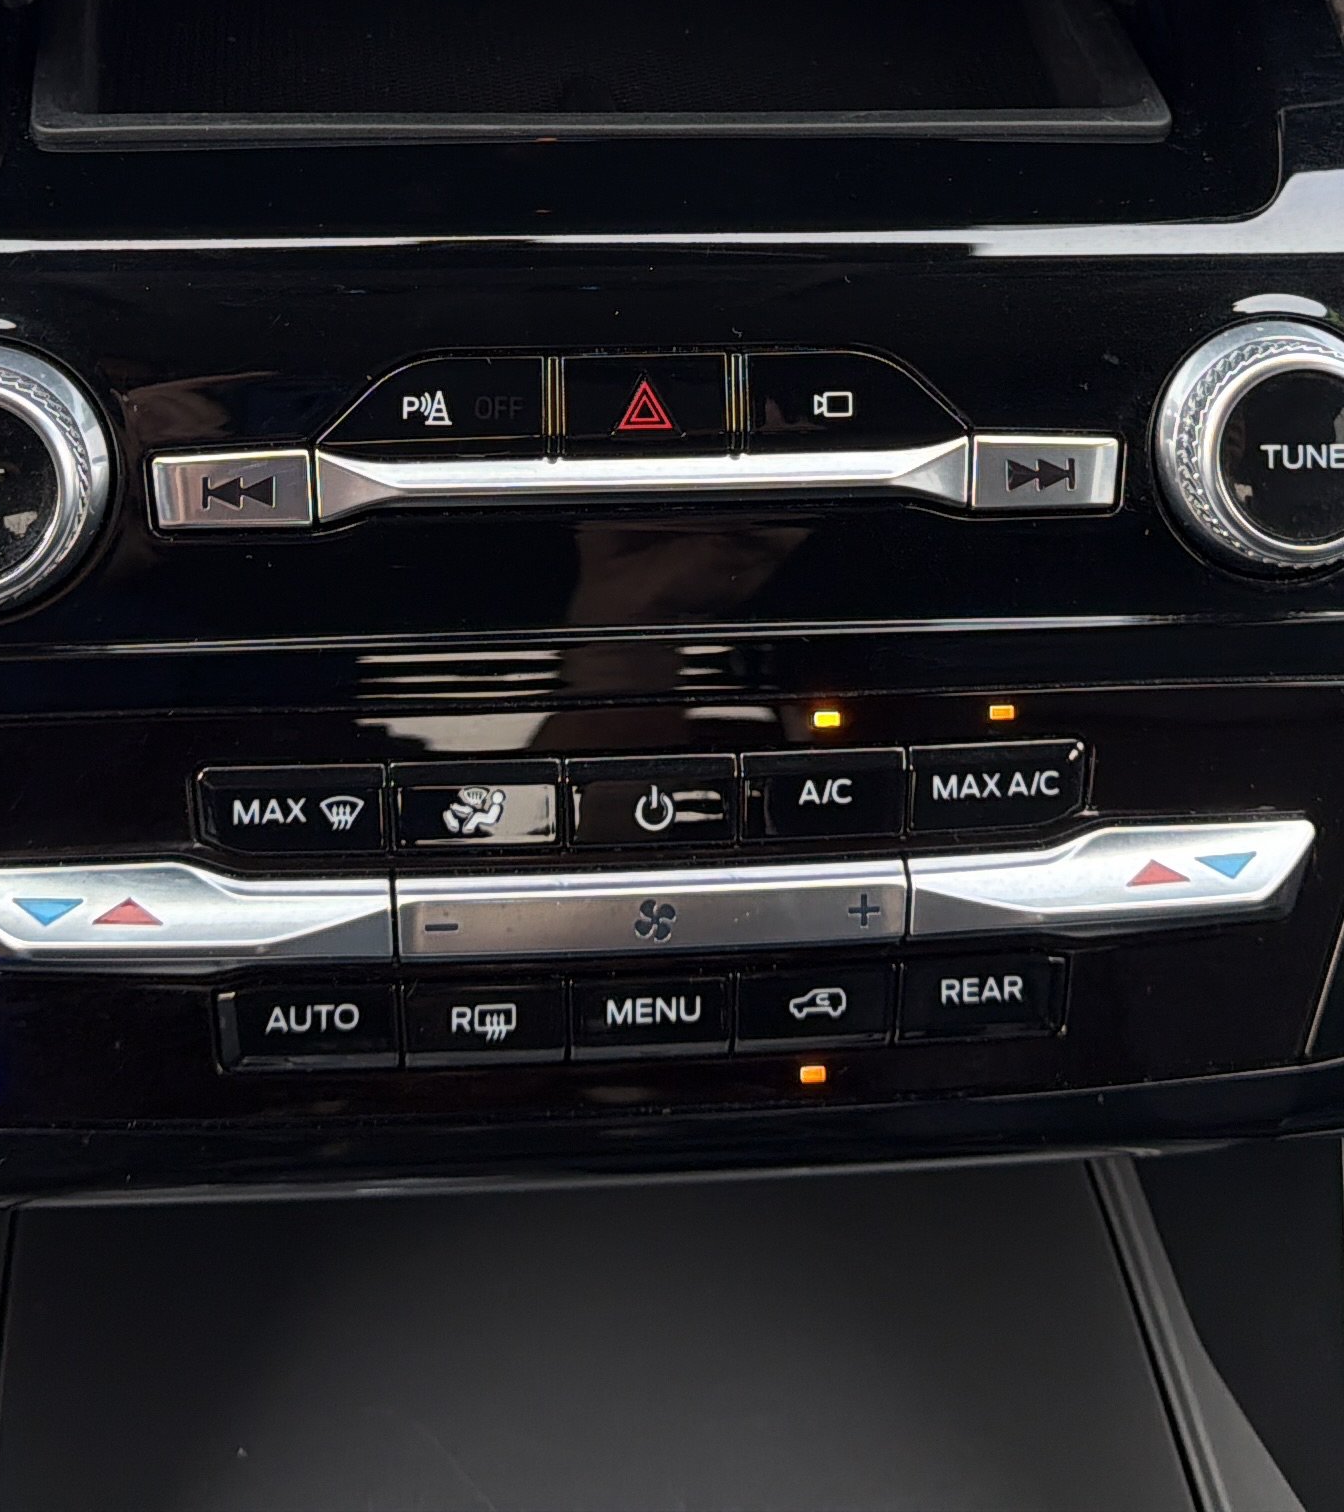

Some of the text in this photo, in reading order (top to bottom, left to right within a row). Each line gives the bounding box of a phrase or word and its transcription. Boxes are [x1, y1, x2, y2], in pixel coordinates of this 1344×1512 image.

[474, 395, 524, 421] OFF
[799, 778, 853, 805] A/C
[931, 771, 1060, 801] MAX A/C
[233, 798, 306, 825] MAX
[940, 975, 1023, 1005] REAR
[265, 1004, 360, 1032] AUTO
[605, 996, 701, 1024] MENU
